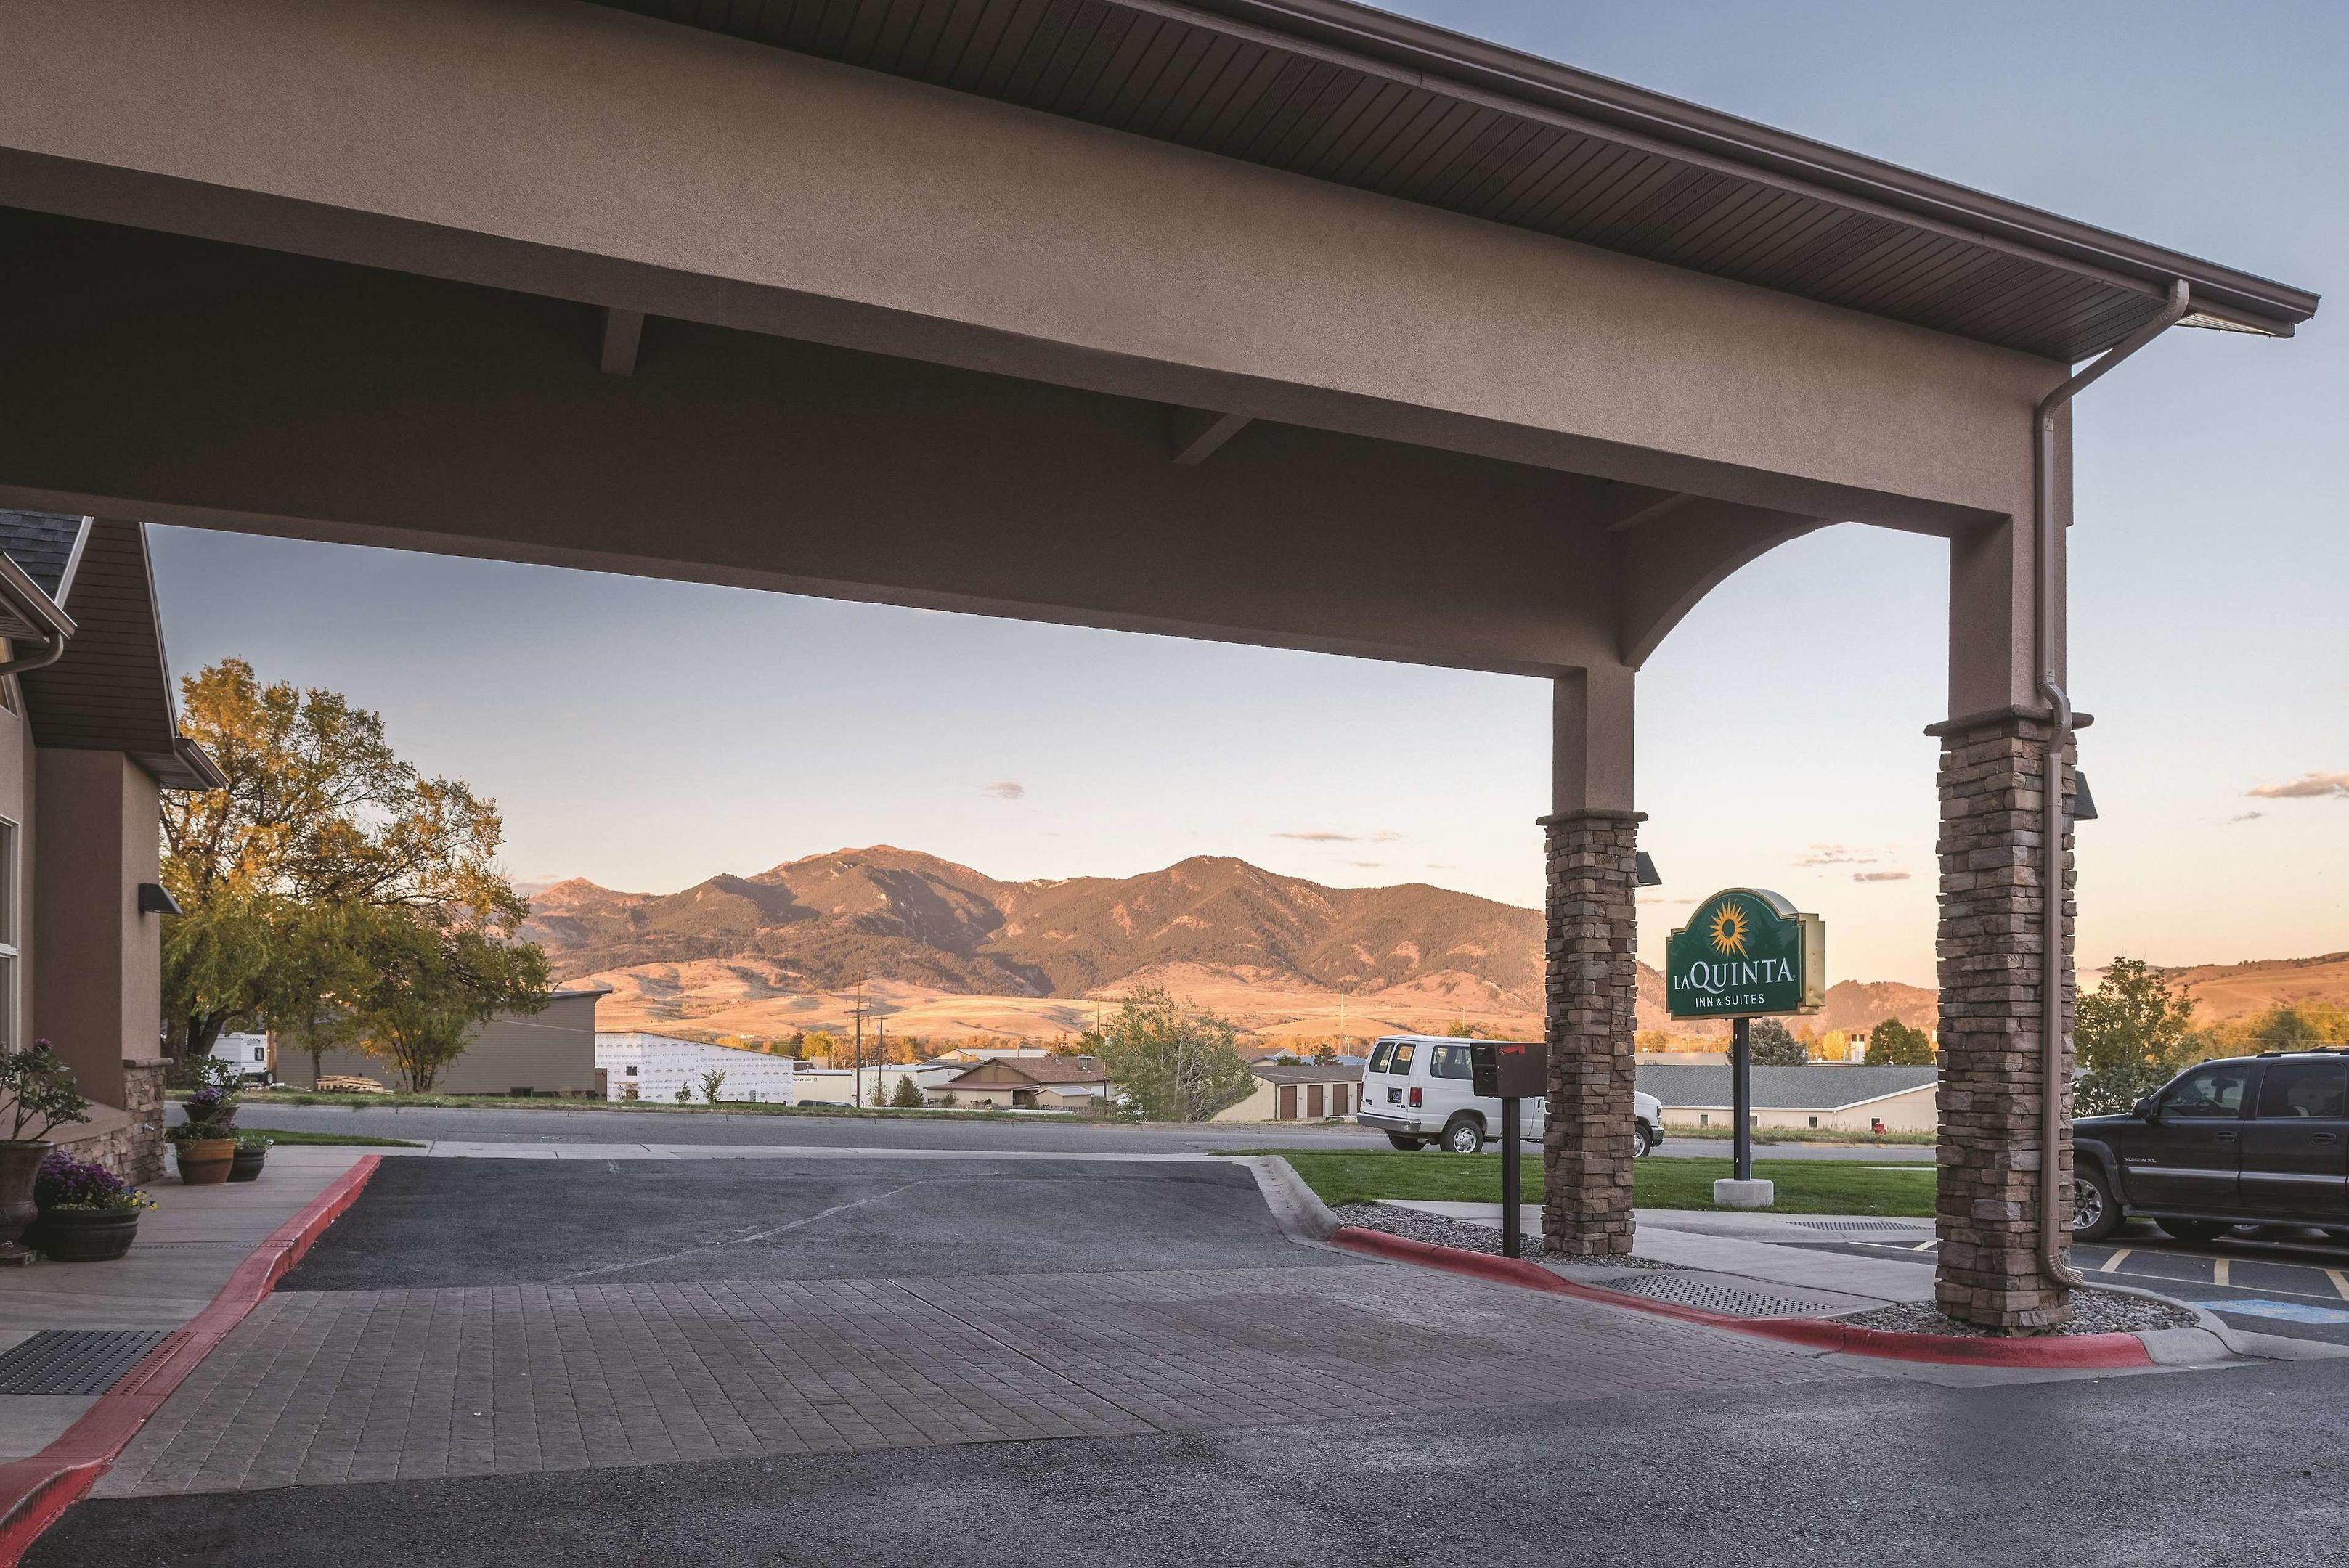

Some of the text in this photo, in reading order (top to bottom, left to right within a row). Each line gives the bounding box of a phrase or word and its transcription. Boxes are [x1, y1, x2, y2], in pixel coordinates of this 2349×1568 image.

[1690, 957, 1795, 995] QUINTA
[1695, 997, 1713, 1008] INN
[1725, 993, 1764, 1006] SUITES
